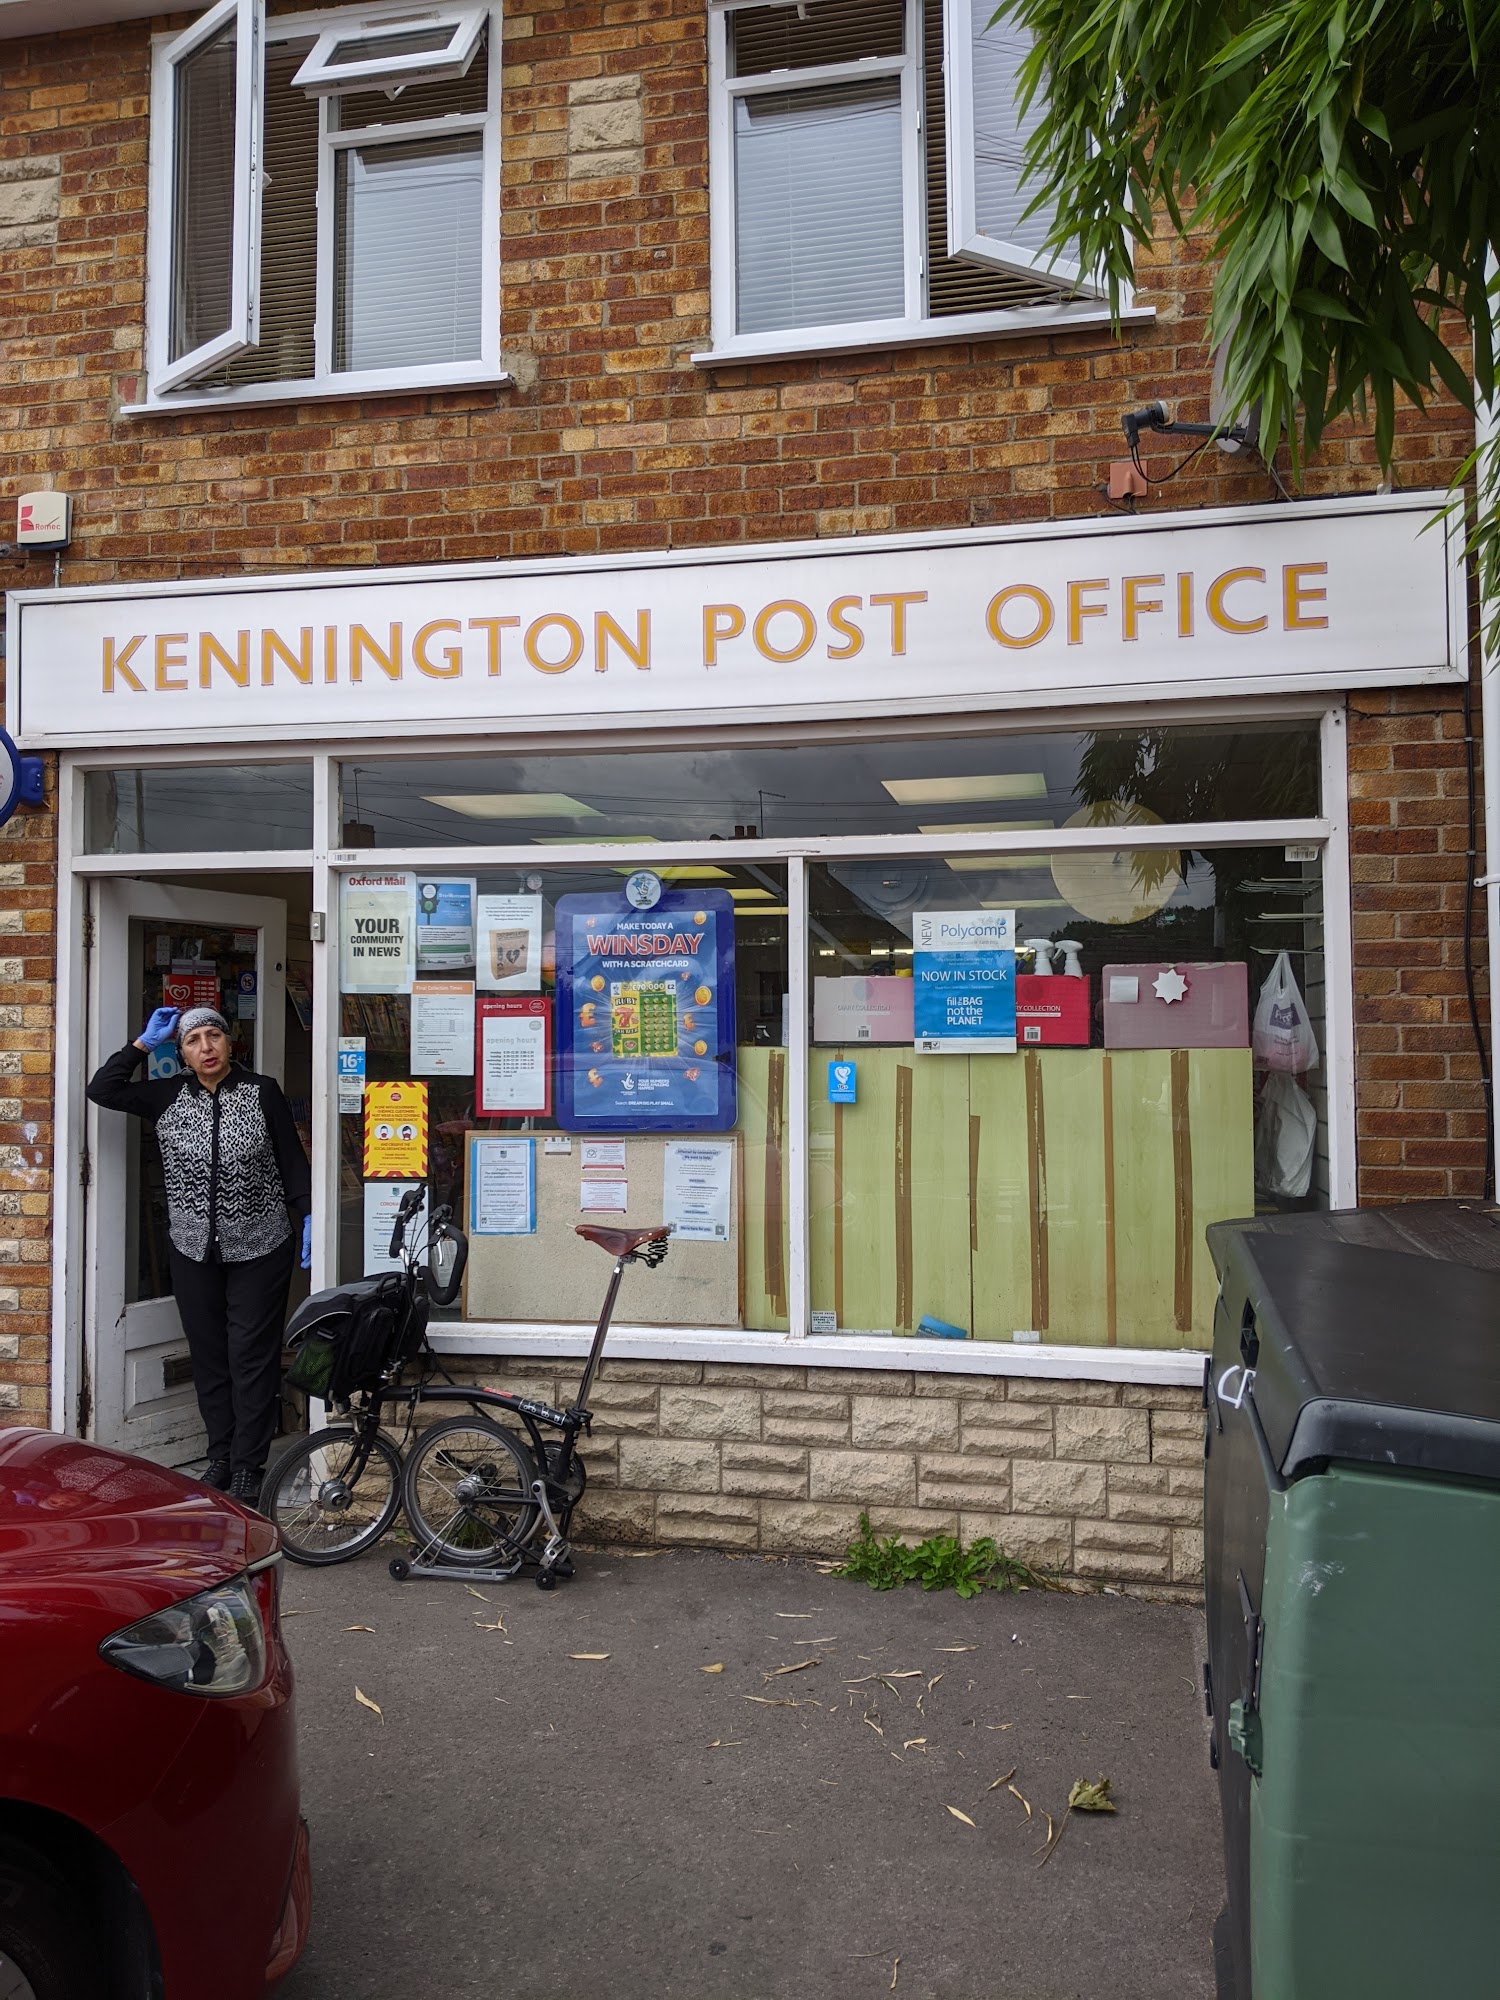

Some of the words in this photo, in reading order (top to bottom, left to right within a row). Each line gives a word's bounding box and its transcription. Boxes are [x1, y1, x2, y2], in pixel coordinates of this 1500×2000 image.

[35, 523, 61, 531] Romec
[102, 609, 651, 693] KENNINGTON
[702, 591, 928, 667] POST
[985, 562, 1329, 649] OFFICE
[349, 876, 383, 886] Oxford
[384, 876, 406, 886] Mail
[354, 918, 400, 934] YOUR
[640, 922, 666, 930] TODAY
[667, 922, 674, 930] A
[921, 919, 932, 946] NEW
[941, 923, 1007, 940] Polycomp
[350, 935, 404, 944] COMMUNITY
[586, 932, 705, 955] WINSDAY
[353, 947, 365, 957] IN
[368, 947, 401, 957] NEWS
[630, 960, 689, 968] SCRATCHCARD
[921, 970, 951, 982] NOW
[953, 970, 966, 981] IN
[969, 969, 1007, 981] STOCK
[615, 997, 636, 1006] RUBY
[946, 996, 957, 1006] fill
[963, 996, 983, 1006] BAG
[946, 1006, 965, 1016] not
[966, 1005, 983, 1016] the
[946, 1016, 983, 1026] PLANET
[486, 1037, 514, 1045] opening
[339, 1053, 364, 1068] 16+
